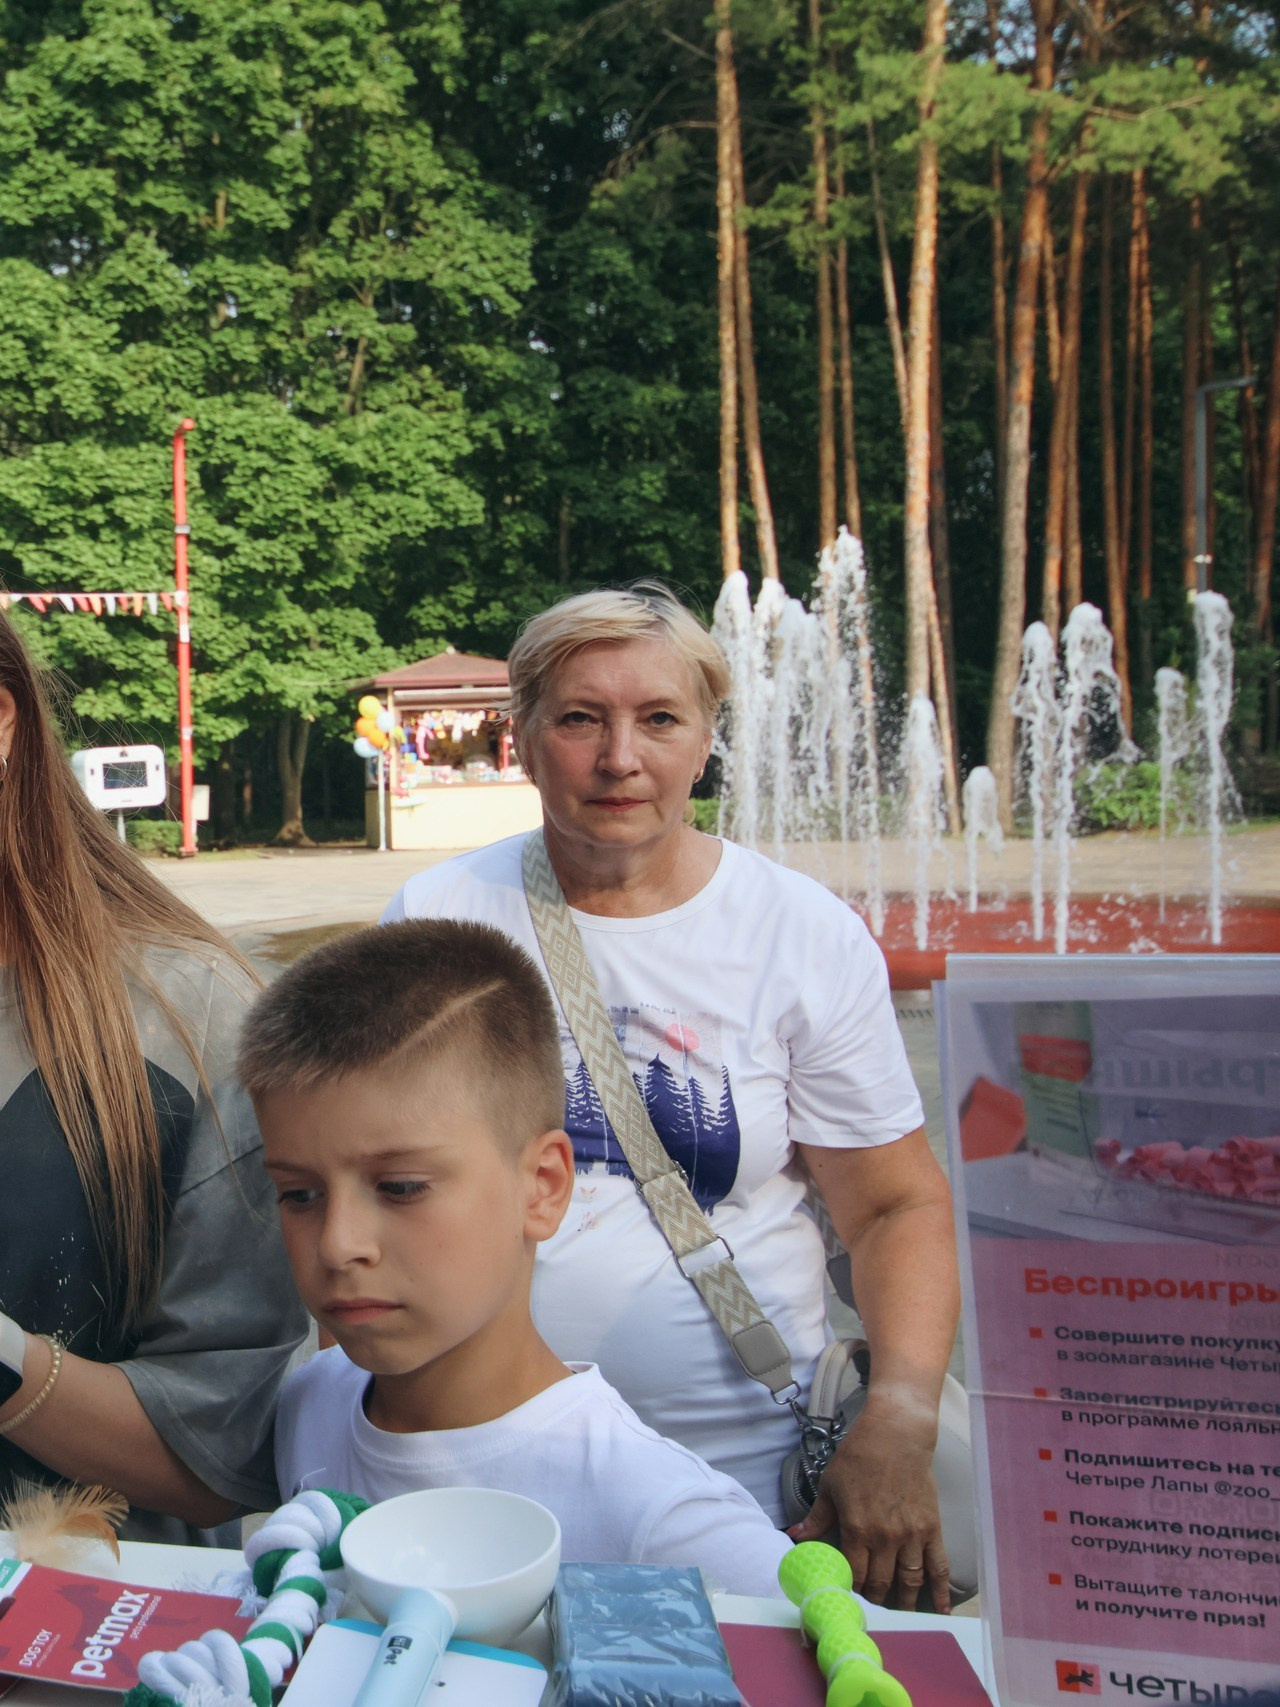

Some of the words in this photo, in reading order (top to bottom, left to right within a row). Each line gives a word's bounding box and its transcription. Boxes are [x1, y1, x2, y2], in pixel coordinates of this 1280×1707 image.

[1054, 1326, 1185, 1347] Совершите
[1057, 1350, 1068, 1361] в
[1073, 1352, 1215, 1370] зоомагазине
[1220, 1356, 1280, 1373] Четы
[1061, 1410, 1073, 1421] в
[1078, 1411, 1200, 1430] программе
[1064, 1449, 1222, 1473] Подпишитесь
[1227, 1462, 1255, 1476] на
[1065, 1471, 1145, 1491] Четыре
[1151, 1476, 1208, 1494] Лапы
[1069, 1511, 1183, 1534] Покажите
[1071, 1535, 1192, 1559] сотруднику
[1074, 1574, 1183, 1597] Вытащите
[1187, 1588, 1280, 1607] талончи
[1076, 1599, 1089, 1611] и
[1094, 1601, 1198, 1621] получите
[1203, 1611, 1266, 1628] приз!
[70, 1589, 150, 1679] petmax
[19, 1644, 41, 1667] DOG
[35, 1629, 53, 1646] TOY
